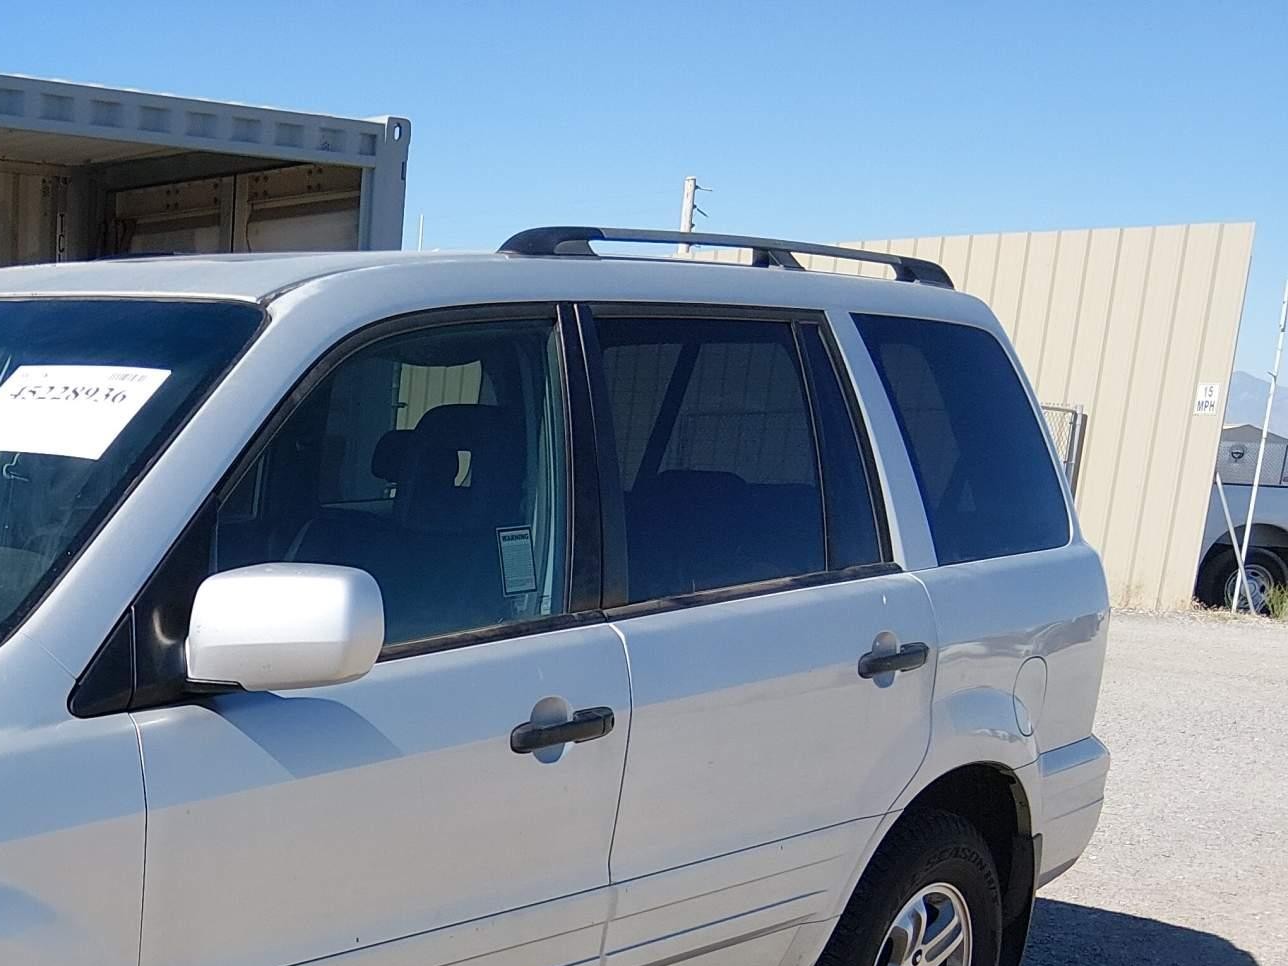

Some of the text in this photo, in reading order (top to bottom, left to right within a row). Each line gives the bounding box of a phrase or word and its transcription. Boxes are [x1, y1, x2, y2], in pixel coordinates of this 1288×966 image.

[9, 385, 127, 403] 45228936
[1203, 384, 1215, 398] 15
[1196, 400, 1216, 412] MPH
[501, 533, 530, 543] WARNING
